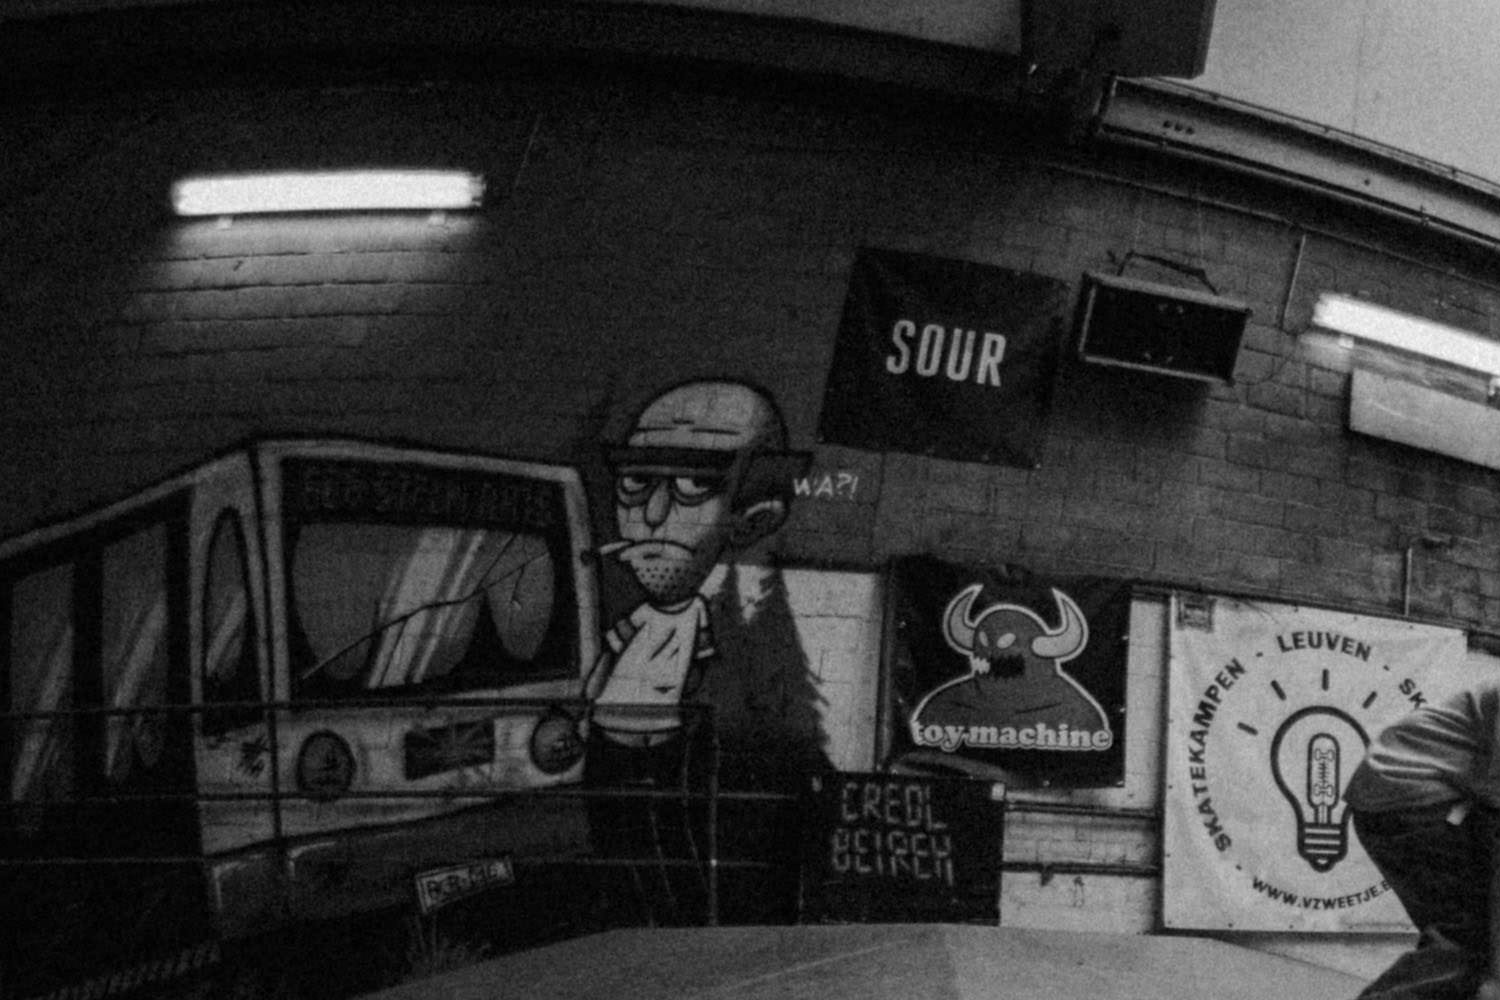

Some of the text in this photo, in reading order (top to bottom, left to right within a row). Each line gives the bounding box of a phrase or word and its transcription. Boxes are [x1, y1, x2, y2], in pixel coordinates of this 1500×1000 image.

[886, 318, 1008, 388] SOUR
[911, 720, 1112, 751] toy machine
[1188, 657, 1247, 853] SKATEKAMPEN
[1276, 630, 1372, 663] LEUVEN
